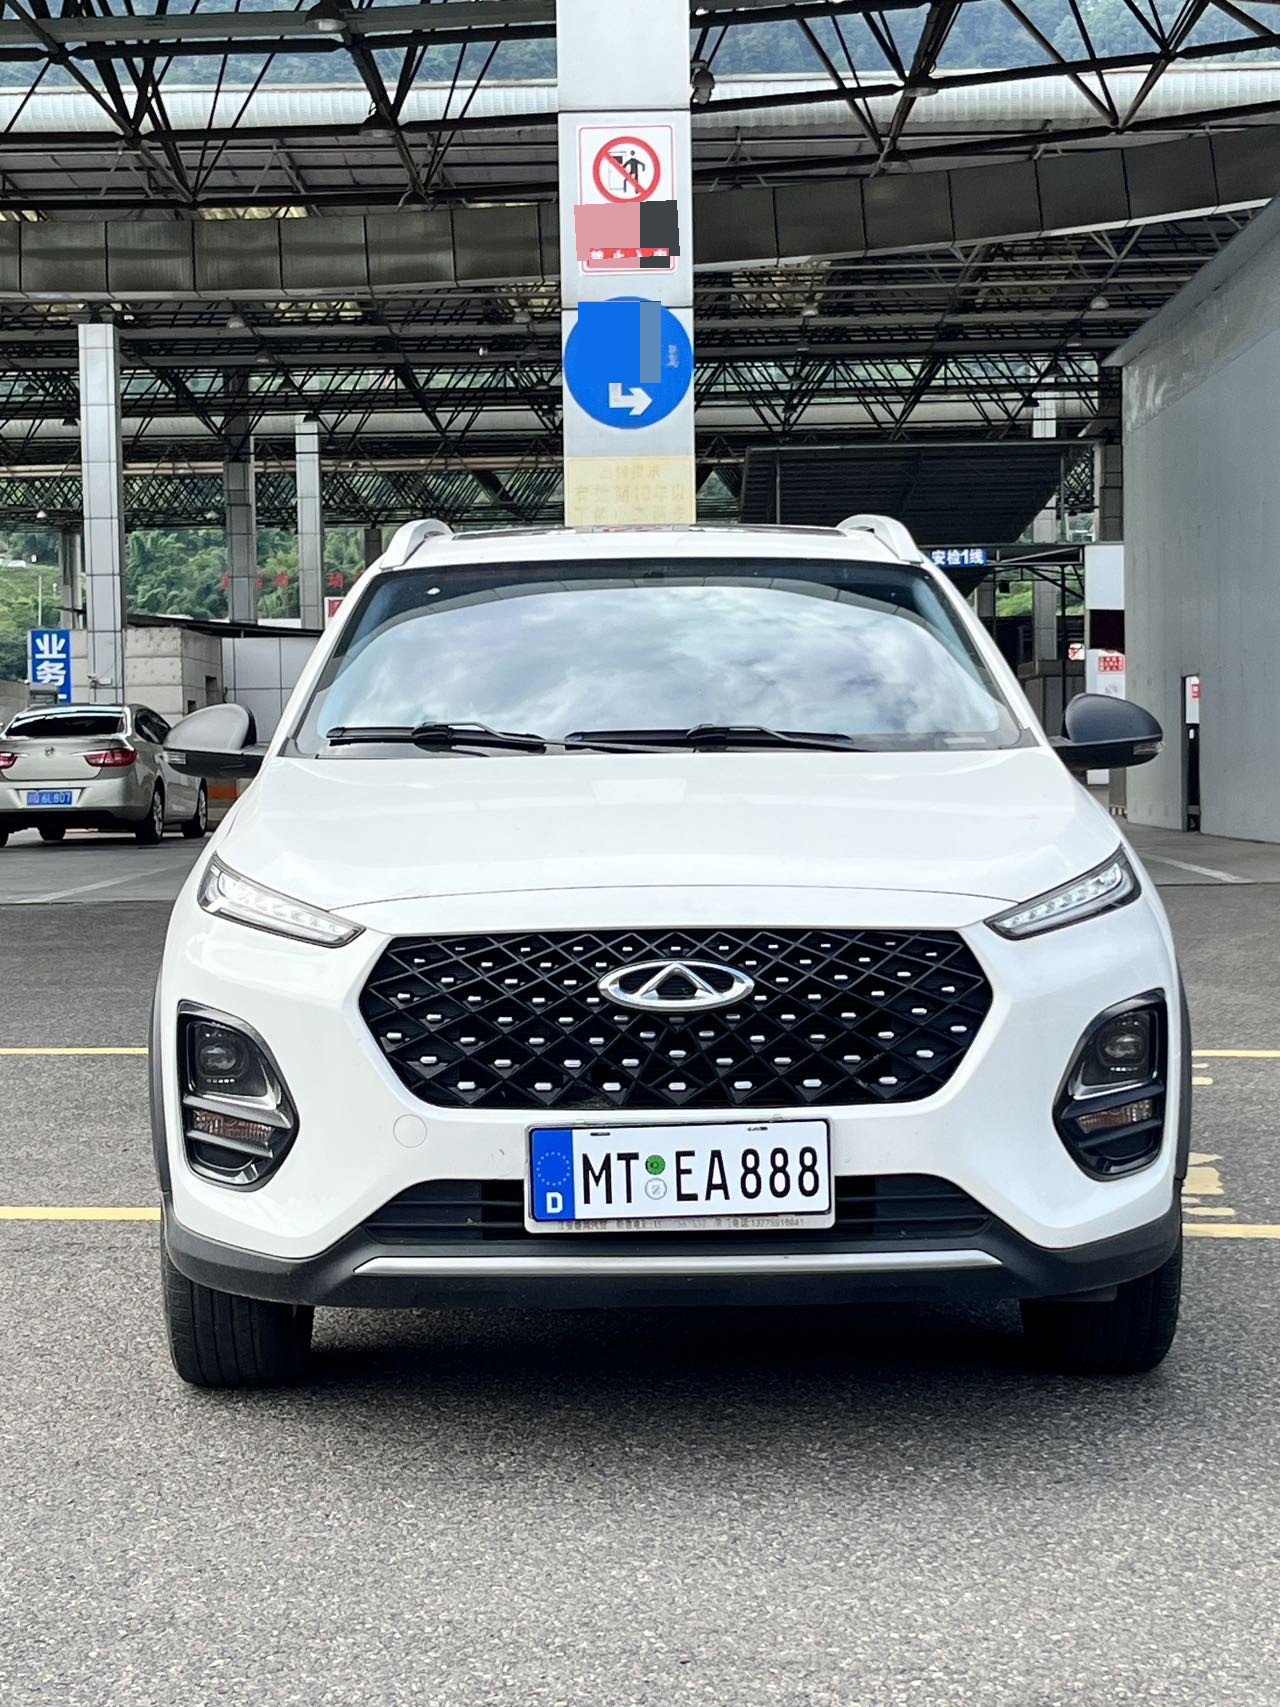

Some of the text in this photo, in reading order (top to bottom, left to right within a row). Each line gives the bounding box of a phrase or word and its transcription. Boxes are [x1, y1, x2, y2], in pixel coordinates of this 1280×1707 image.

[931, 548, 984, 566] 安检1线
[35, 633, 67, 700] 业务
[582, 1145, 820, 1205] MT EA888
[546, 1191, 563, 1214] D
